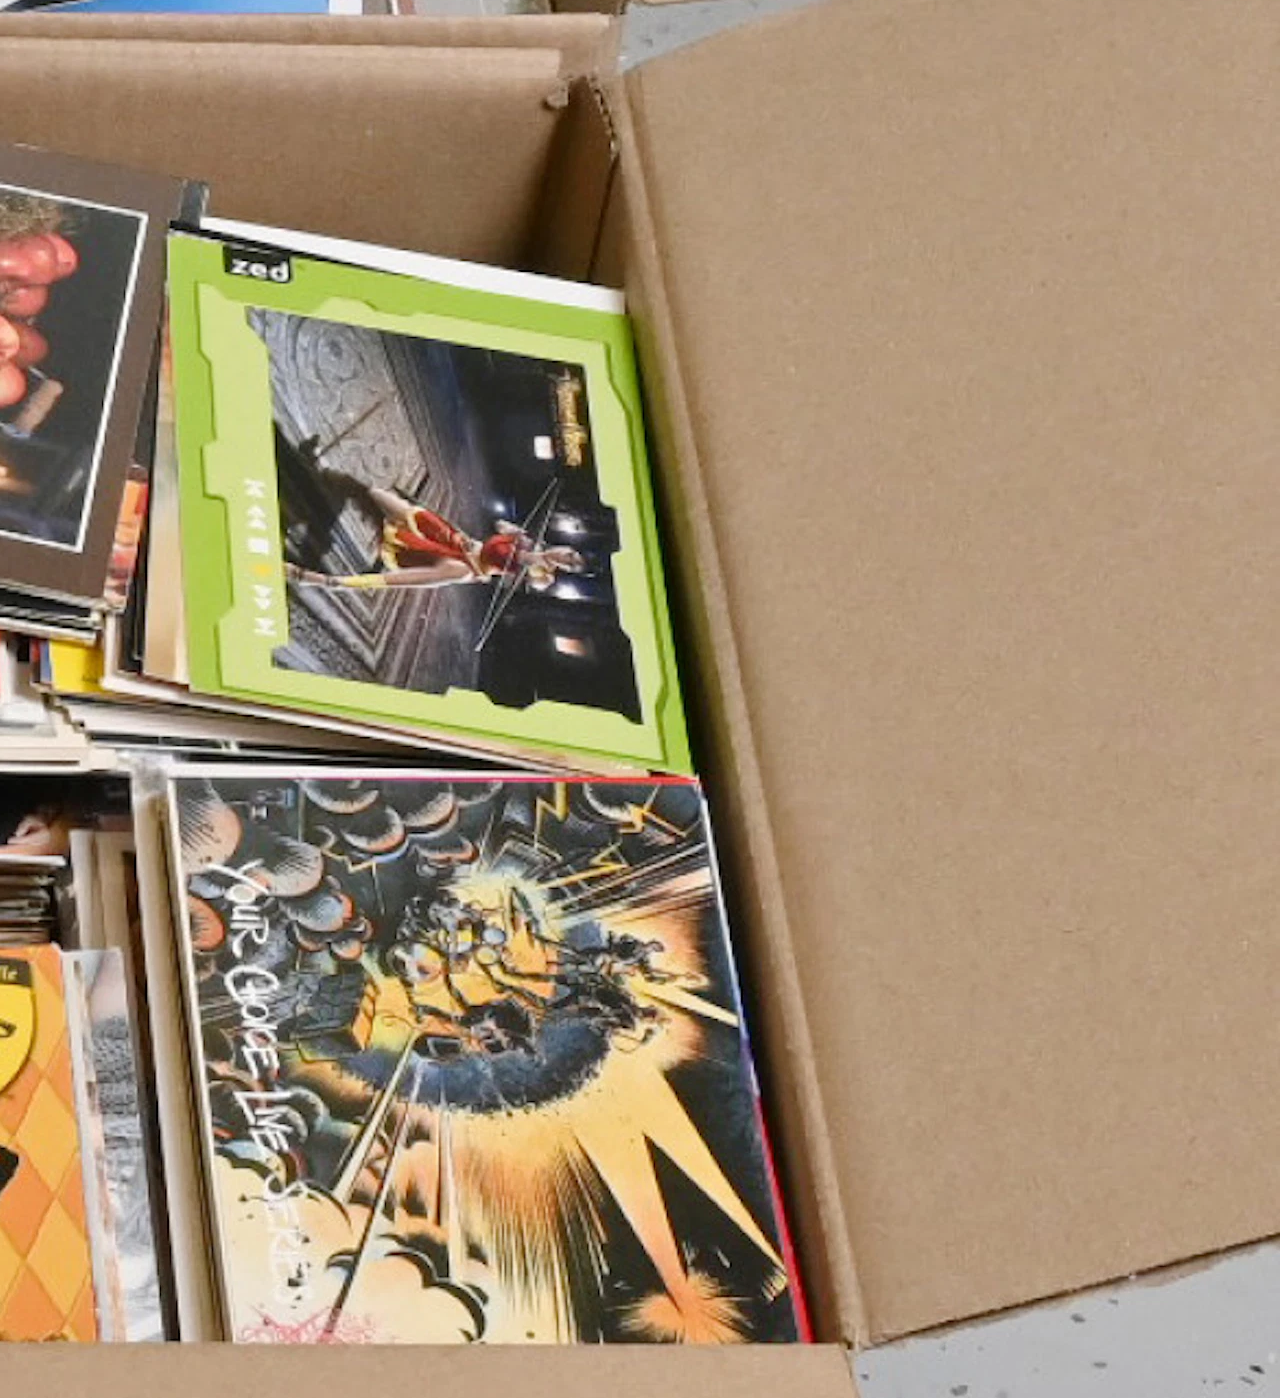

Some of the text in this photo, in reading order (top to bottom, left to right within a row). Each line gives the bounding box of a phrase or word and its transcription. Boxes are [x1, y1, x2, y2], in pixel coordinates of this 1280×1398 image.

[229, 258, 289, 283] zed
[206, 857, 270, 959] YOUR
[224, 964, 281, 1082] CHOICE
[233, 1090, 294, 1153] LIVE
